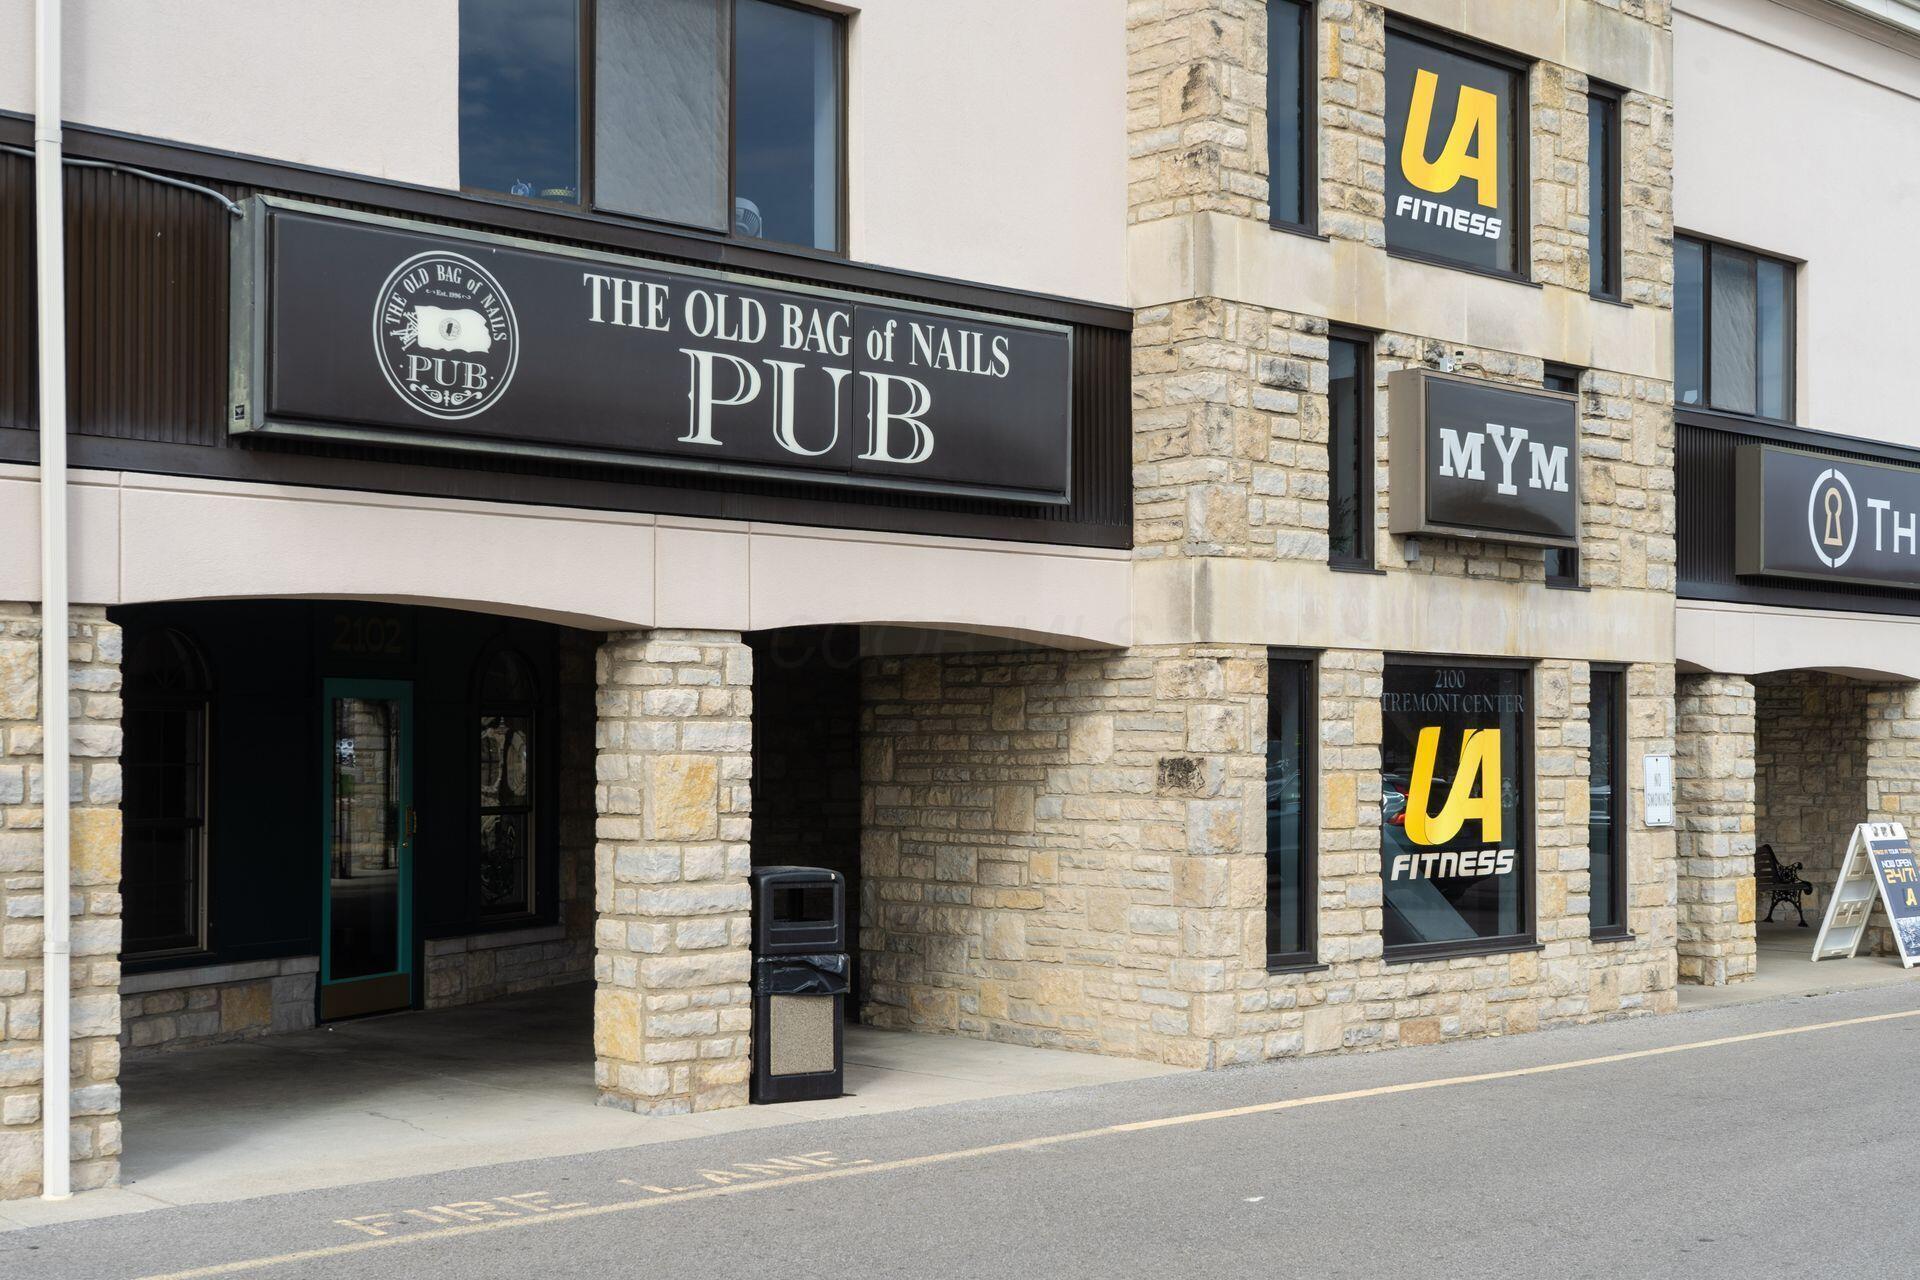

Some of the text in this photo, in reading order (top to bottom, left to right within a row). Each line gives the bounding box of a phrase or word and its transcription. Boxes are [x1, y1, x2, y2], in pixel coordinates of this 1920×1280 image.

[1401, 68, 1497, 209] UA
[1395, 194, 1502, 240] FITNESS
[385, 292, 408, 325] THE
[403, 268, 430, 294] OLD
[436, 264, 463, 284] BAG
[467, 279, 483, 295] of
[480, 293, 507, 342] NAILS
[583, 273, 1010, 378] THE OLD BAG of NAILS
[405, 354, 488, 390] PUB
[677, 348, 935, 464] PUB
[1439, 423, 1569, 496] MYM
[331, 615, 404, 654] 2102
[1381, 692, 1525, 713] TREMONT CENTER
[1434, 669, 1466, 689] 2100
[1404, 726, 1502, 846] UA
[1390, 849, 1515, 881] FITNESS
[334, 1151, 873, 1236] FIRE LANE
